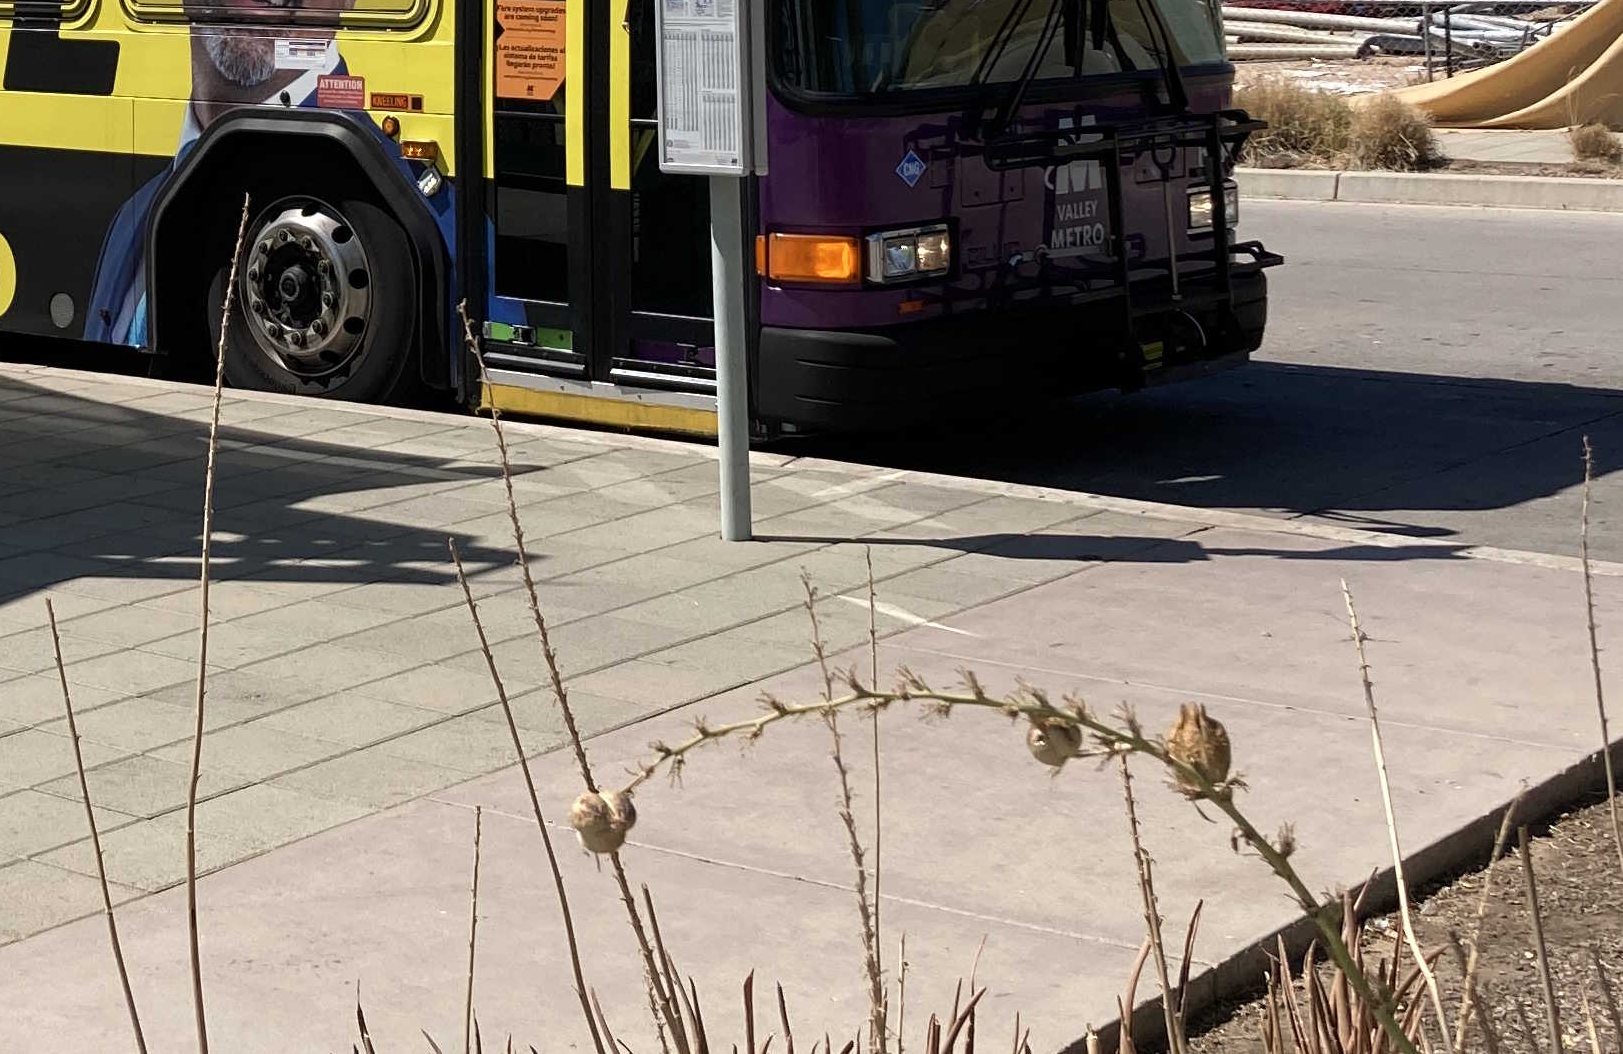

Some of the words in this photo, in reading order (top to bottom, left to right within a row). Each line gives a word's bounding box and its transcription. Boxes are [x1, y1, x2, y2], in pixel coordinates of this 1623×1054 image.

[319, 78, 363, 90] ATTENTION
[372, 95, 407, 106] KNEELING
[1057, 200, 1098, 221] VALLEY
[1050, 222, 1105, 248] METRO
